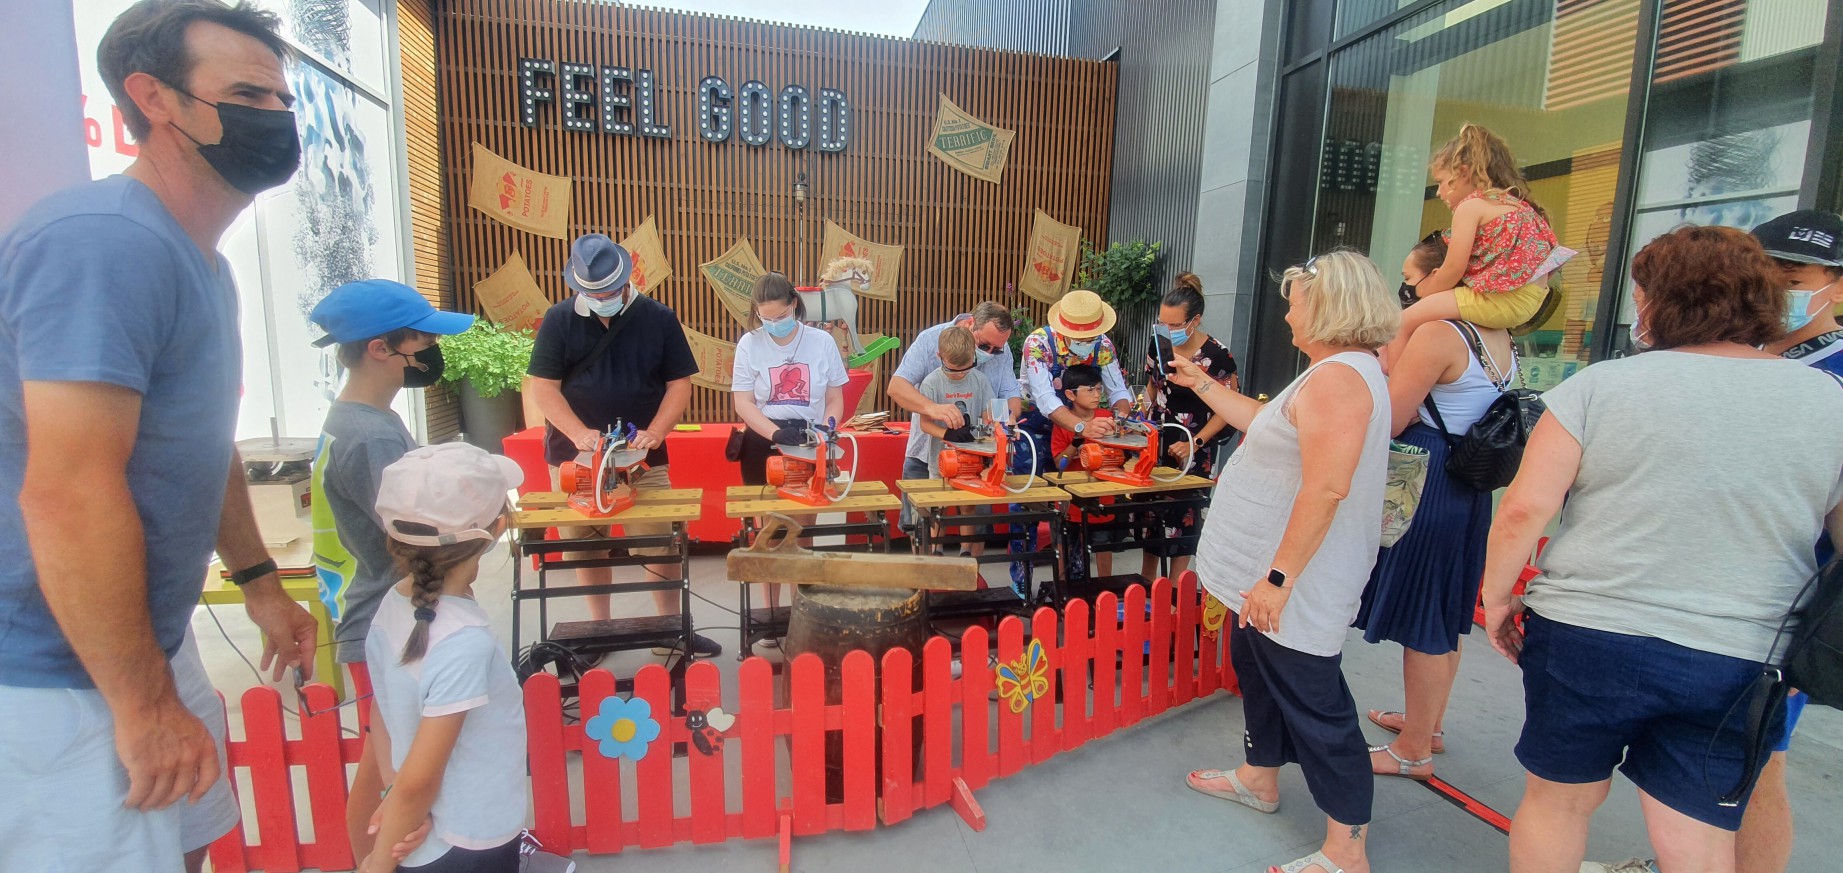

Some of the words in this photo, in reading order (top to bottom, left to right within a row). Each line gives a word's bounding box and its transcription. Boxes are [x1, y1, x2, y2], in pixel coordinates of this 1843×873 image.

[520, 56, 671, 140] FEEL
[699, 75, 849, 153] GOOD
[939, 129, 988, 149] TERRIFIC
[522, 179, 532, 217] POTATOES
[712, 264, 754, 295] TERRI
